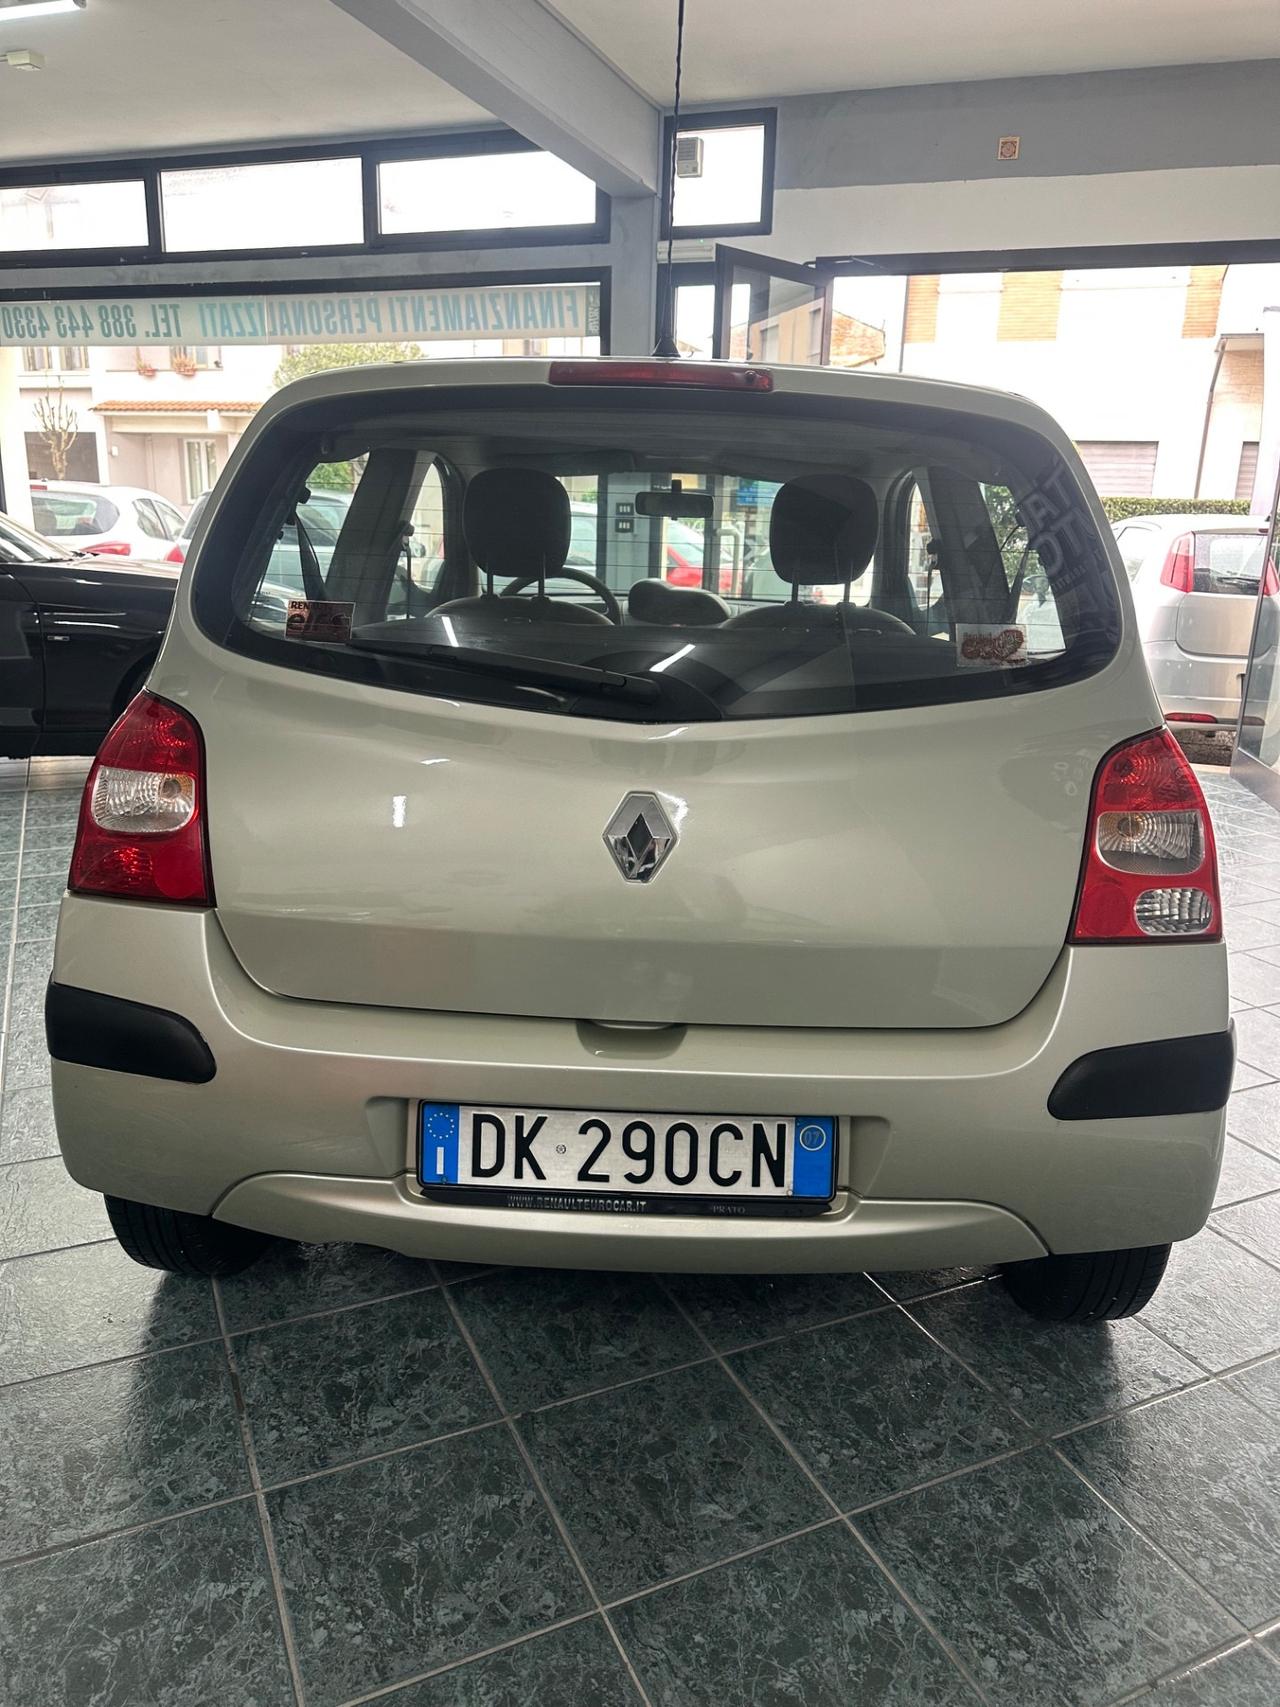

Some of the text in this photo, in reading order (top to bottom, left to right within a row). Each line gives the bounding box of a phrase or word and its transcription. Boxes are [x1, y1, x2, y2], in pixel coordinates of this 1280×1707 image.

[470, 1112, 788, 1188] DK 290CN
[507, 1194, 648, 1213] WWW.RENAULTEUROCAR.IT
[712, 1204, 746, 1214] PRATO
